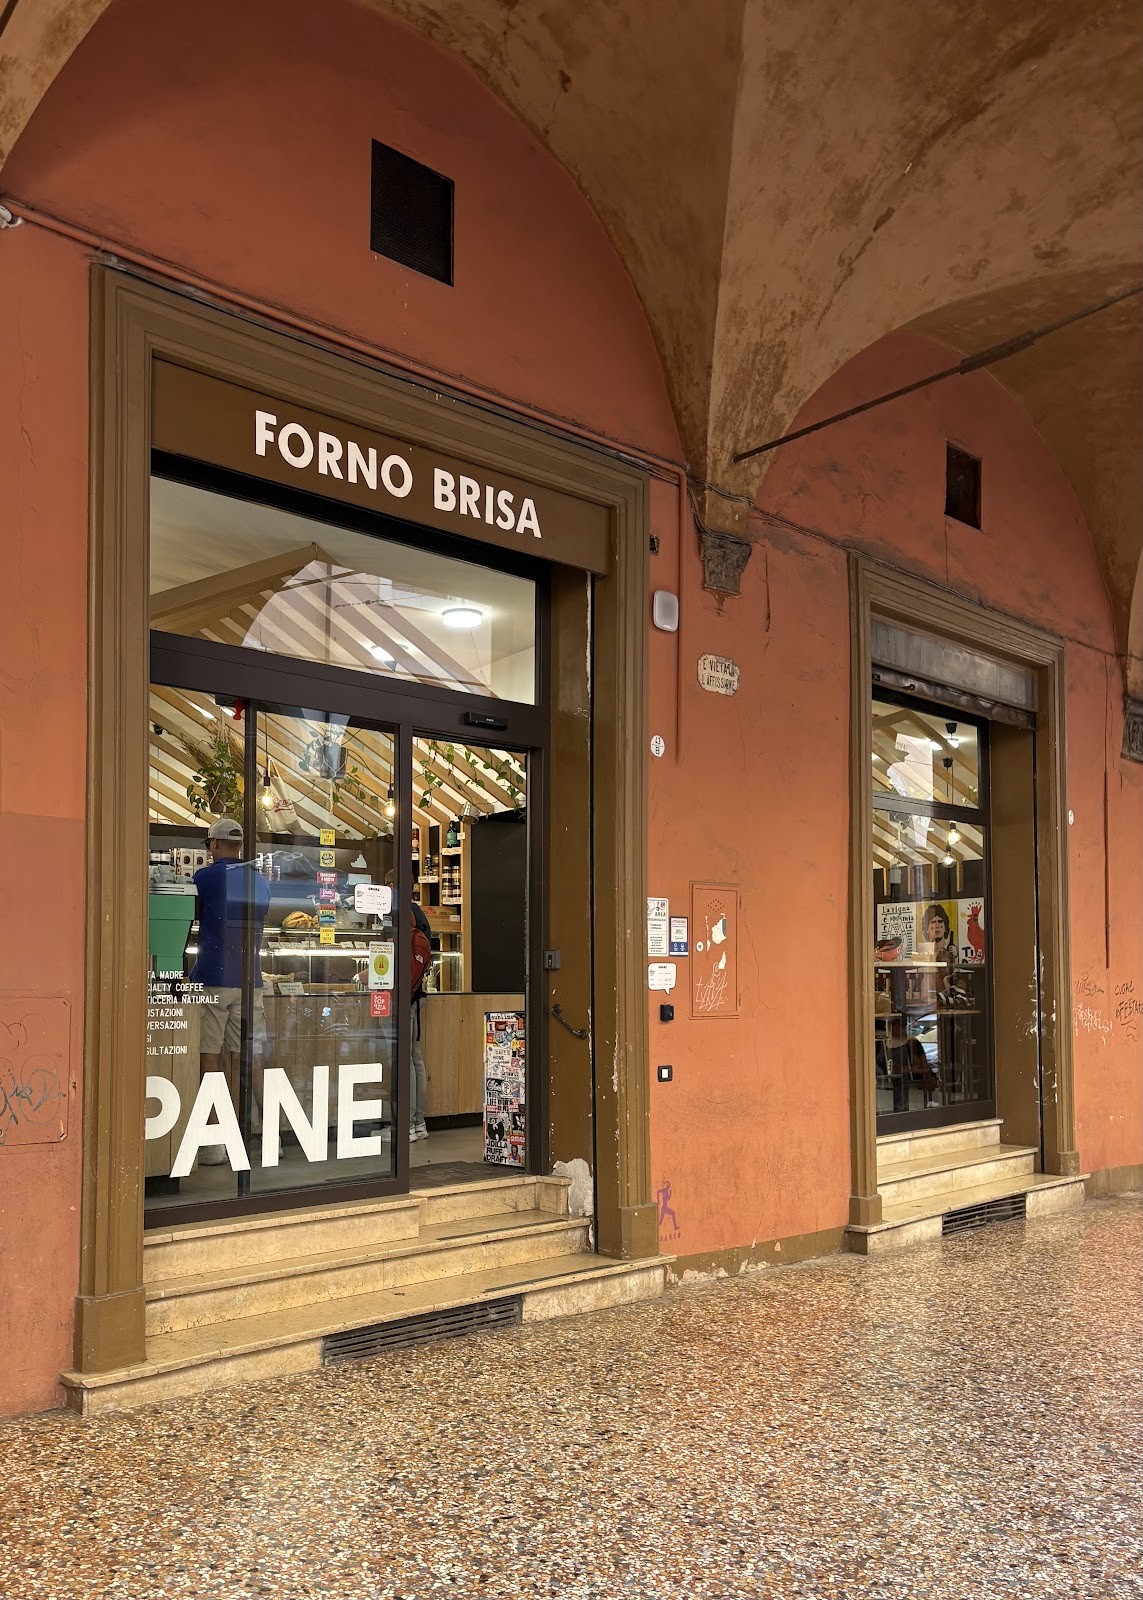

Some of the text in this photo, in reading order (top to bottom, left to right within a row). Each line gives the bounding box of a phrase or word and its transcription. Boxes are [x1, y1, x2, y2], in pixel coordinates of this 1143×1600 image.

[255, 409, 542, 539] FORNO BRISA
[160, 971, 184, 980] MADRE
[175, 983, 204, 992] COFFEE
[182, 995, 219, 1004] NATURALE
[145, 1063, 382, 1178] PANE
